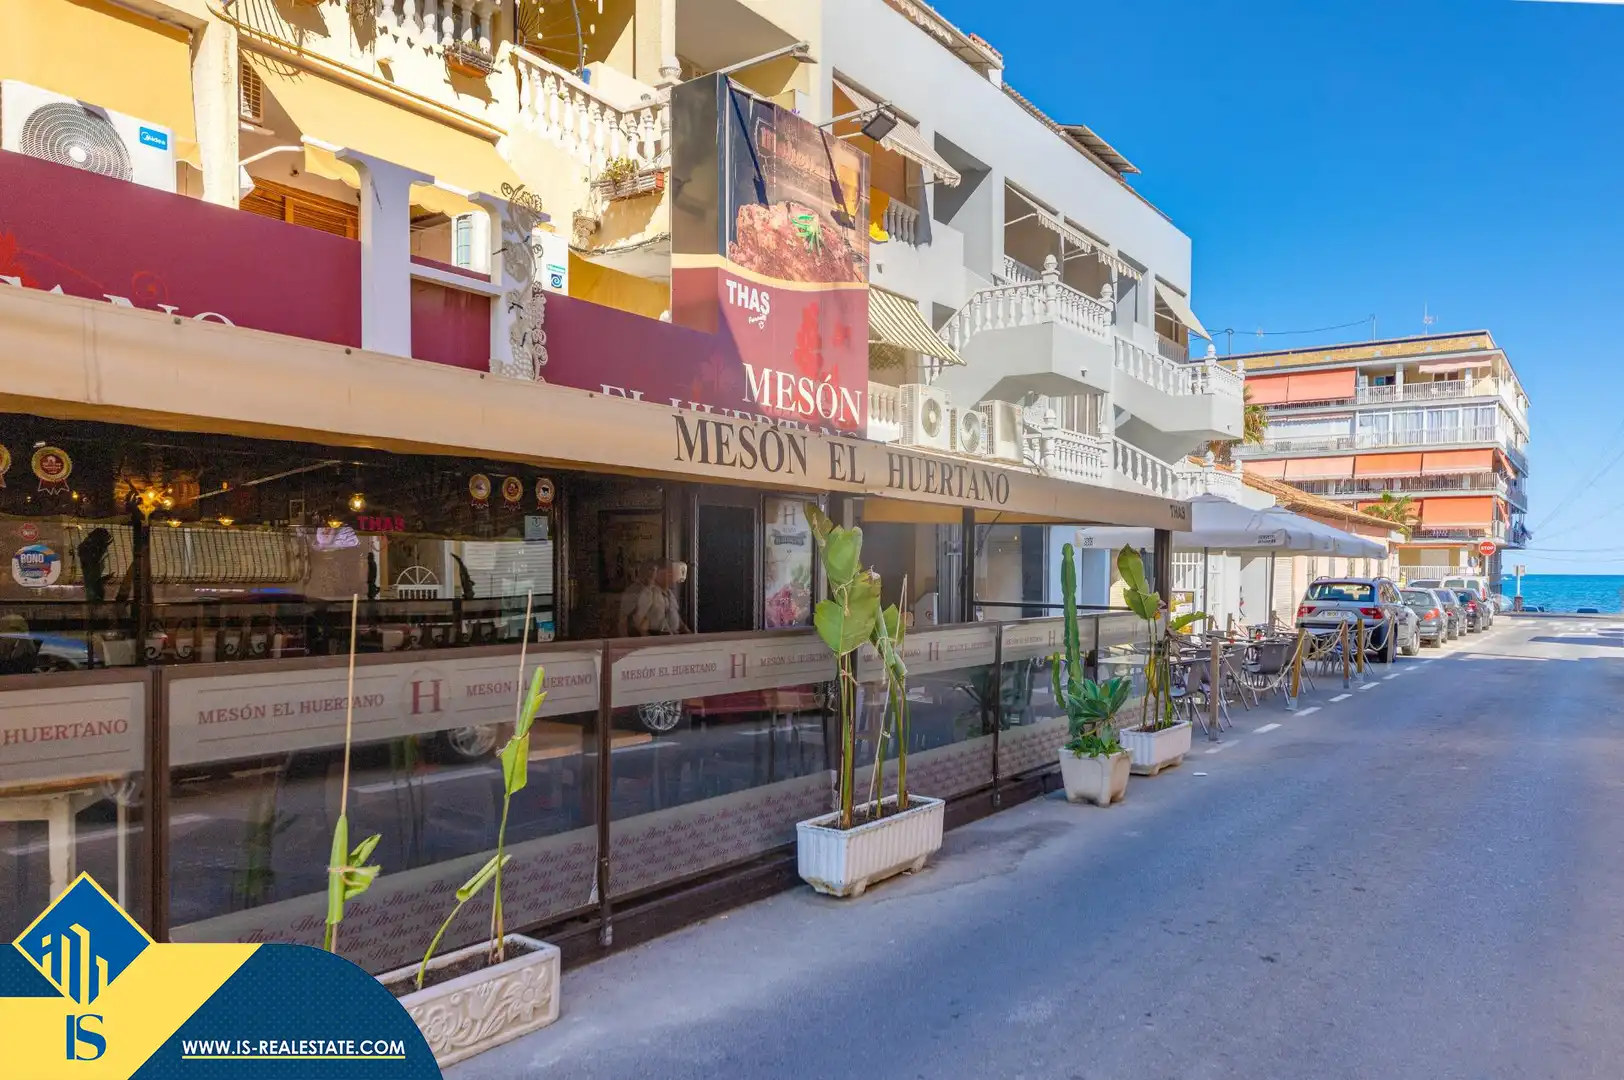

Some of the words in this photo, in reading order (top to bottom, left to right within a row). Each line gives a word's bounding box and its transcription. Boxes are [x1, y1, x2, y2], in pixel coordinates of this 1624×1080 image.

[725, 278, 770, 316] THAS
[742, 362, 862, 425] MESÓN
[672, 414, 807, 476] MESÓN
[827, 440, 865, 484] EL
[886, 451, 1010, 505] HUERTANO
[542, 673, 593, 689] UERTANO
[728, 653, 749, 679] H
[410, 679, 443, 714] H
[198, 703, 267, 725] MESÓN
[272, 702, 296, 717] EL
[3, 719, 129, 747] HUERTANO
